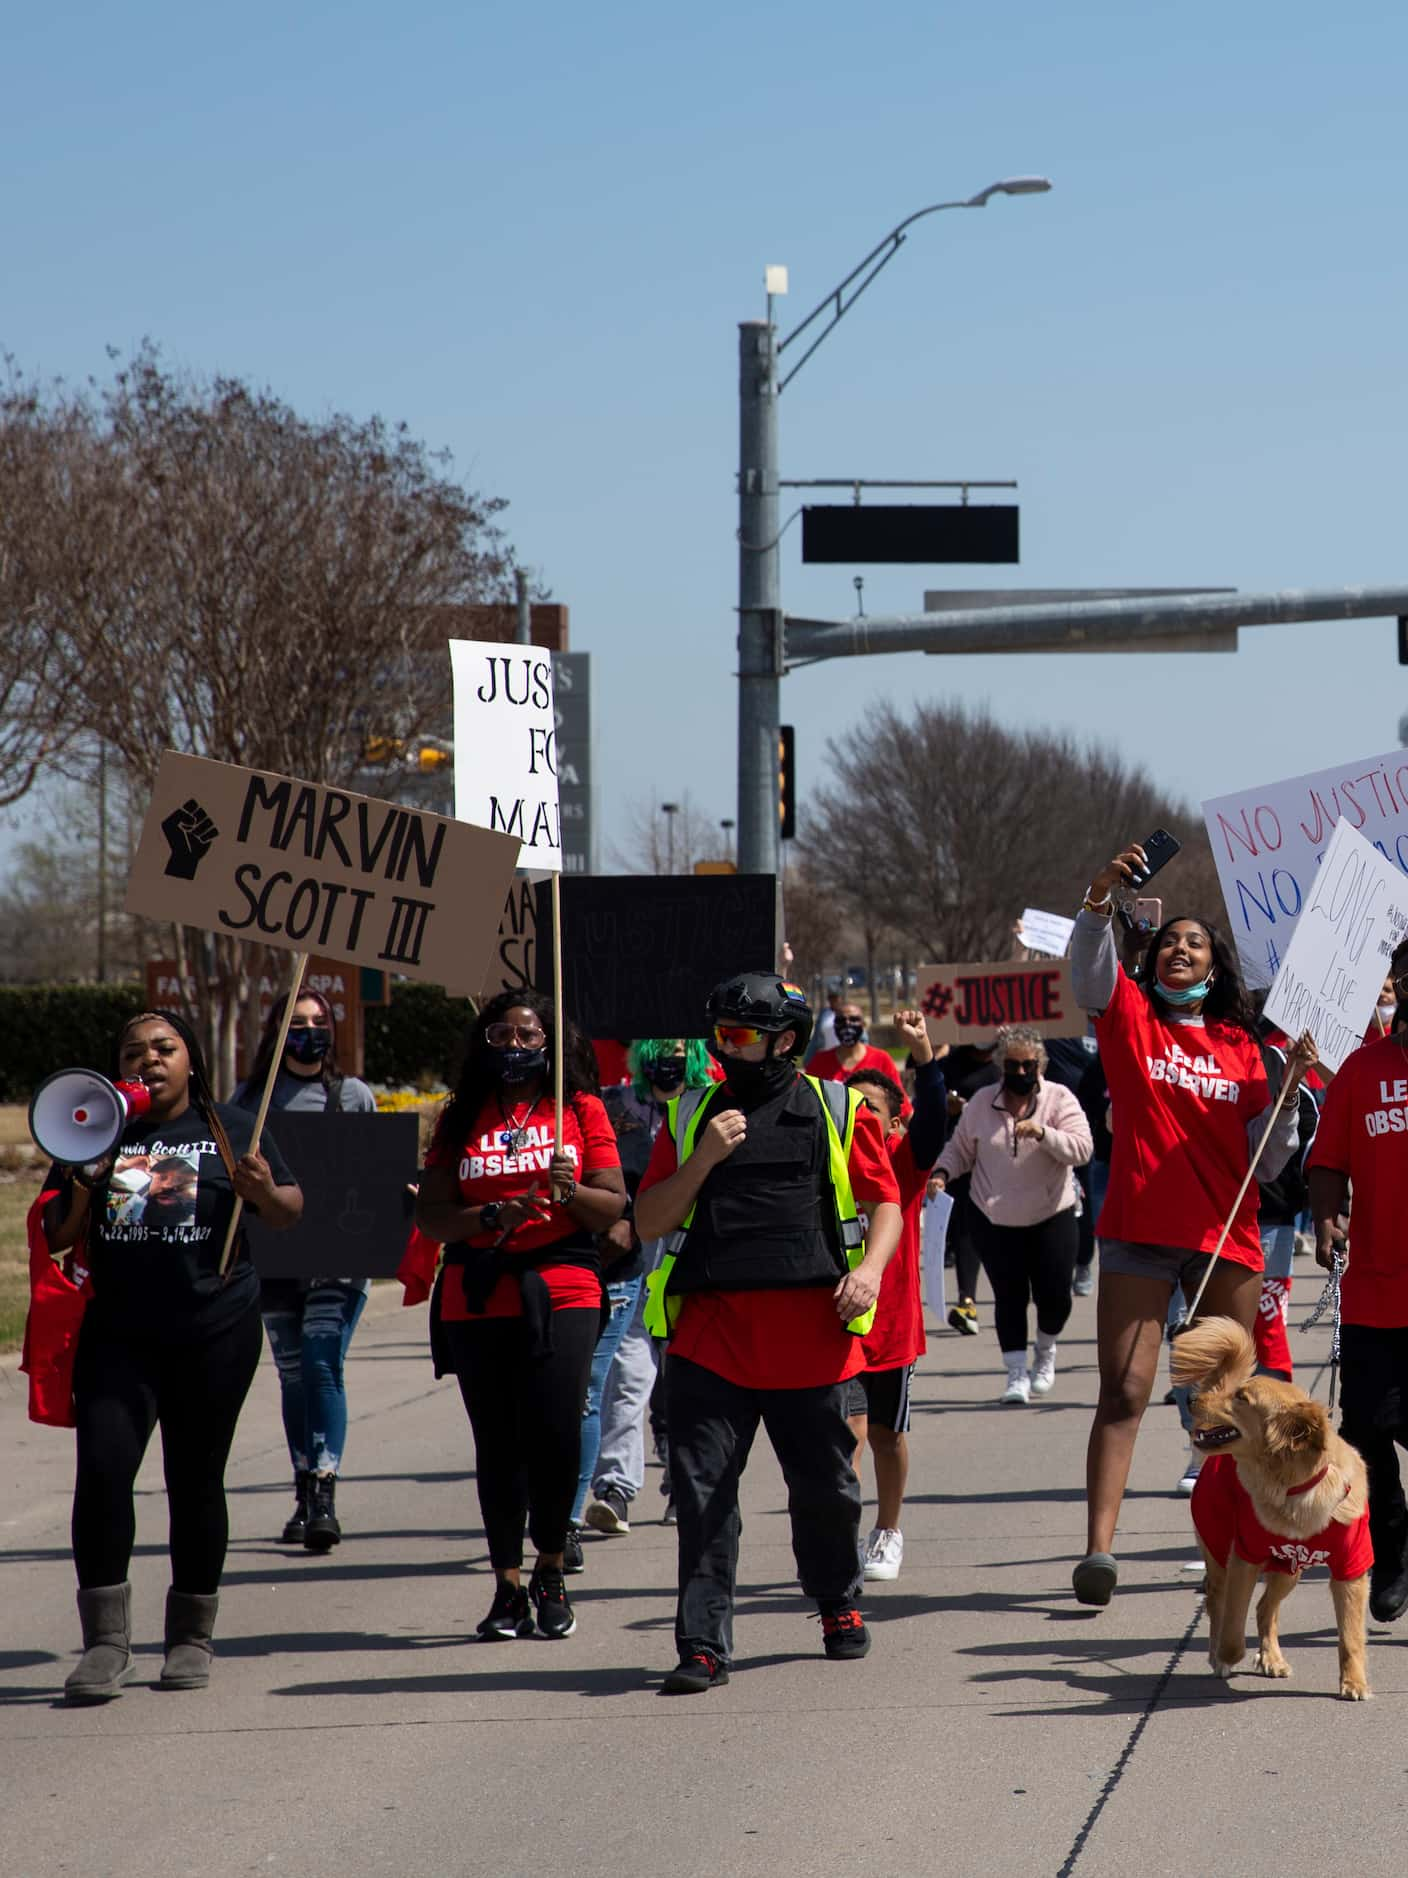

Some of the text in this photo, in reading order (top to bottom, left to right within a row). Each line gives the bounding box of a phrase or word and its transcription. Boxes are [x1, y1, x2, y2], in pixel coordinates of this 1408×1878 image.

[477, 657, 552, 710] JUS
[237, 775, 447, 888] MARVIN
[1216, 804, 1282, 863] NO
[218, 863, 436, 966] SCOTT III
[1235, 867, 1302, 932] NO
[1310, 826, 1386, 968] LONG
[920, 968, 1065, 1027] #JUSTICE
[1319, 950, 1358, 1014] LIVE
[458, 1143, 579, 1182] OBSERVR
[480, 1124, 558, 1153] LEAL
